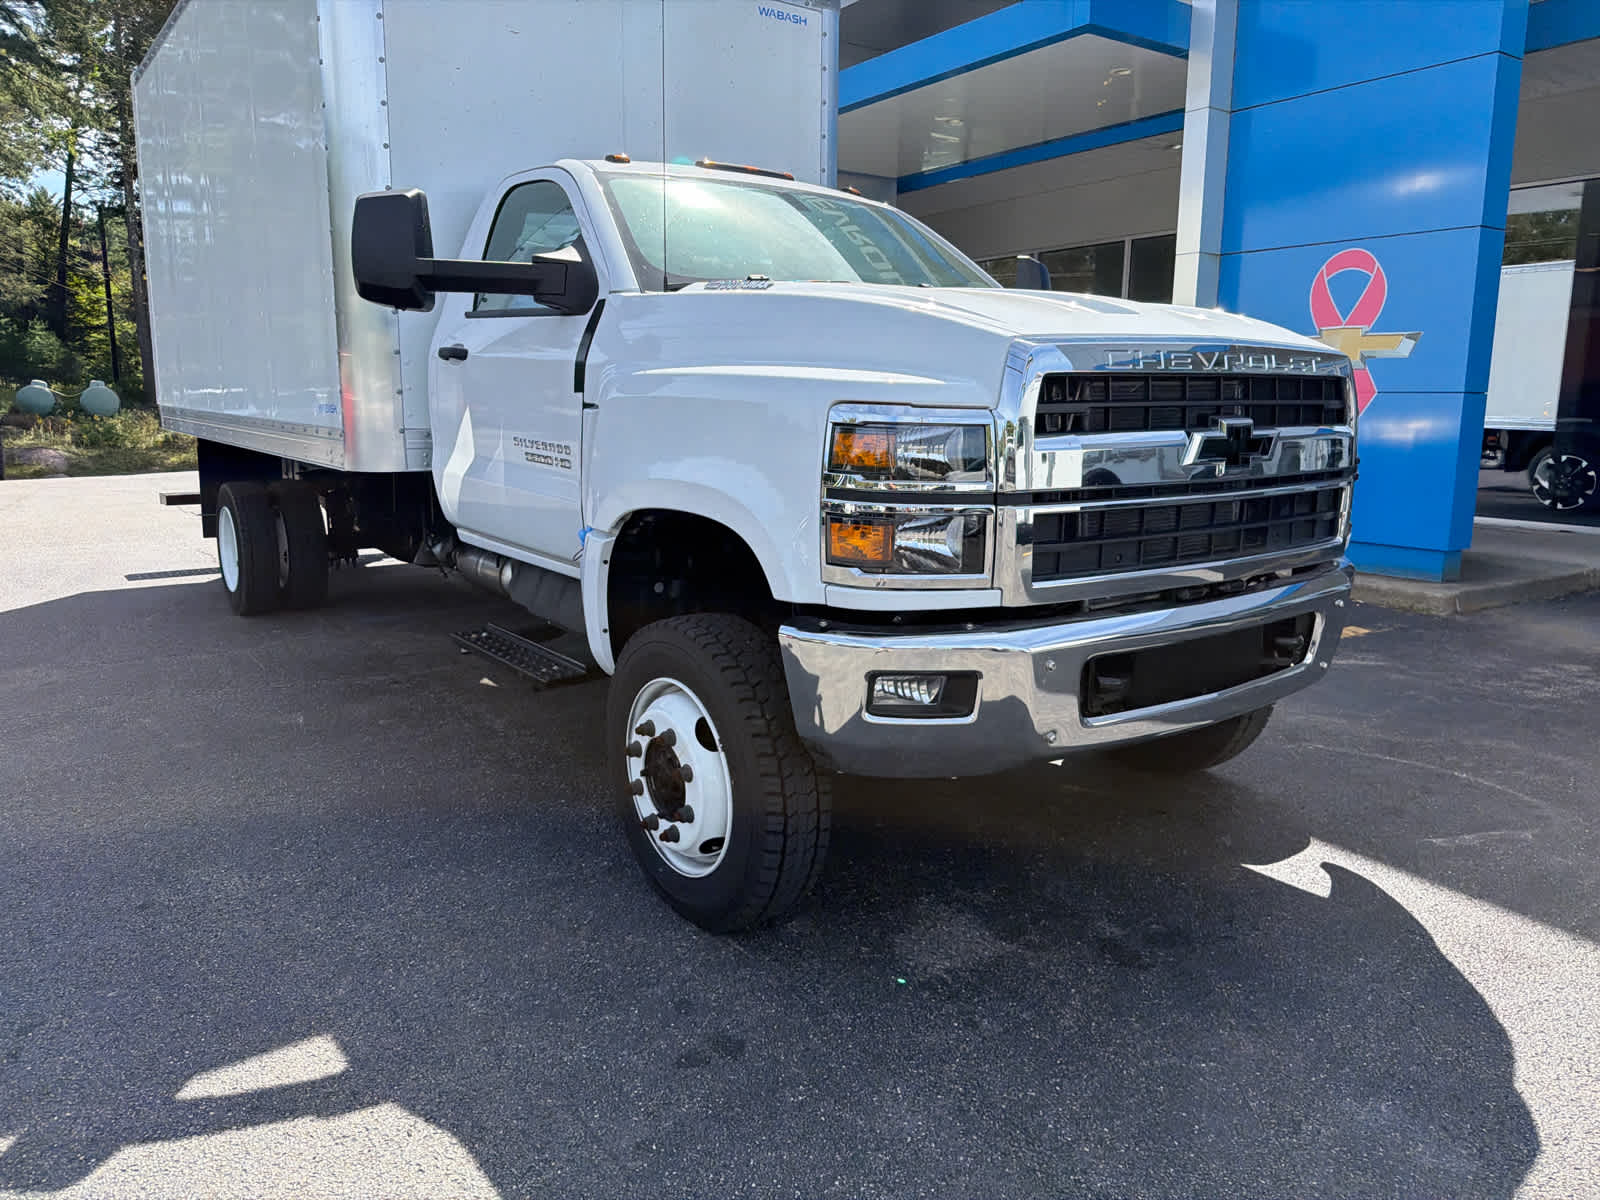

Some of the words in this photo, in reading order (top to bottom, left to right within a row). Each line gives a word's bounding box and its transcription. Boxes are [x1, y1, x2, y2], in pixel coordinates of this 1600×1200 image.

[758, 6, 808, 26] WABASH
[1104, 350, 1321, 373] CHEVROLET
[513, 436, 572, 456] SILVERADO
